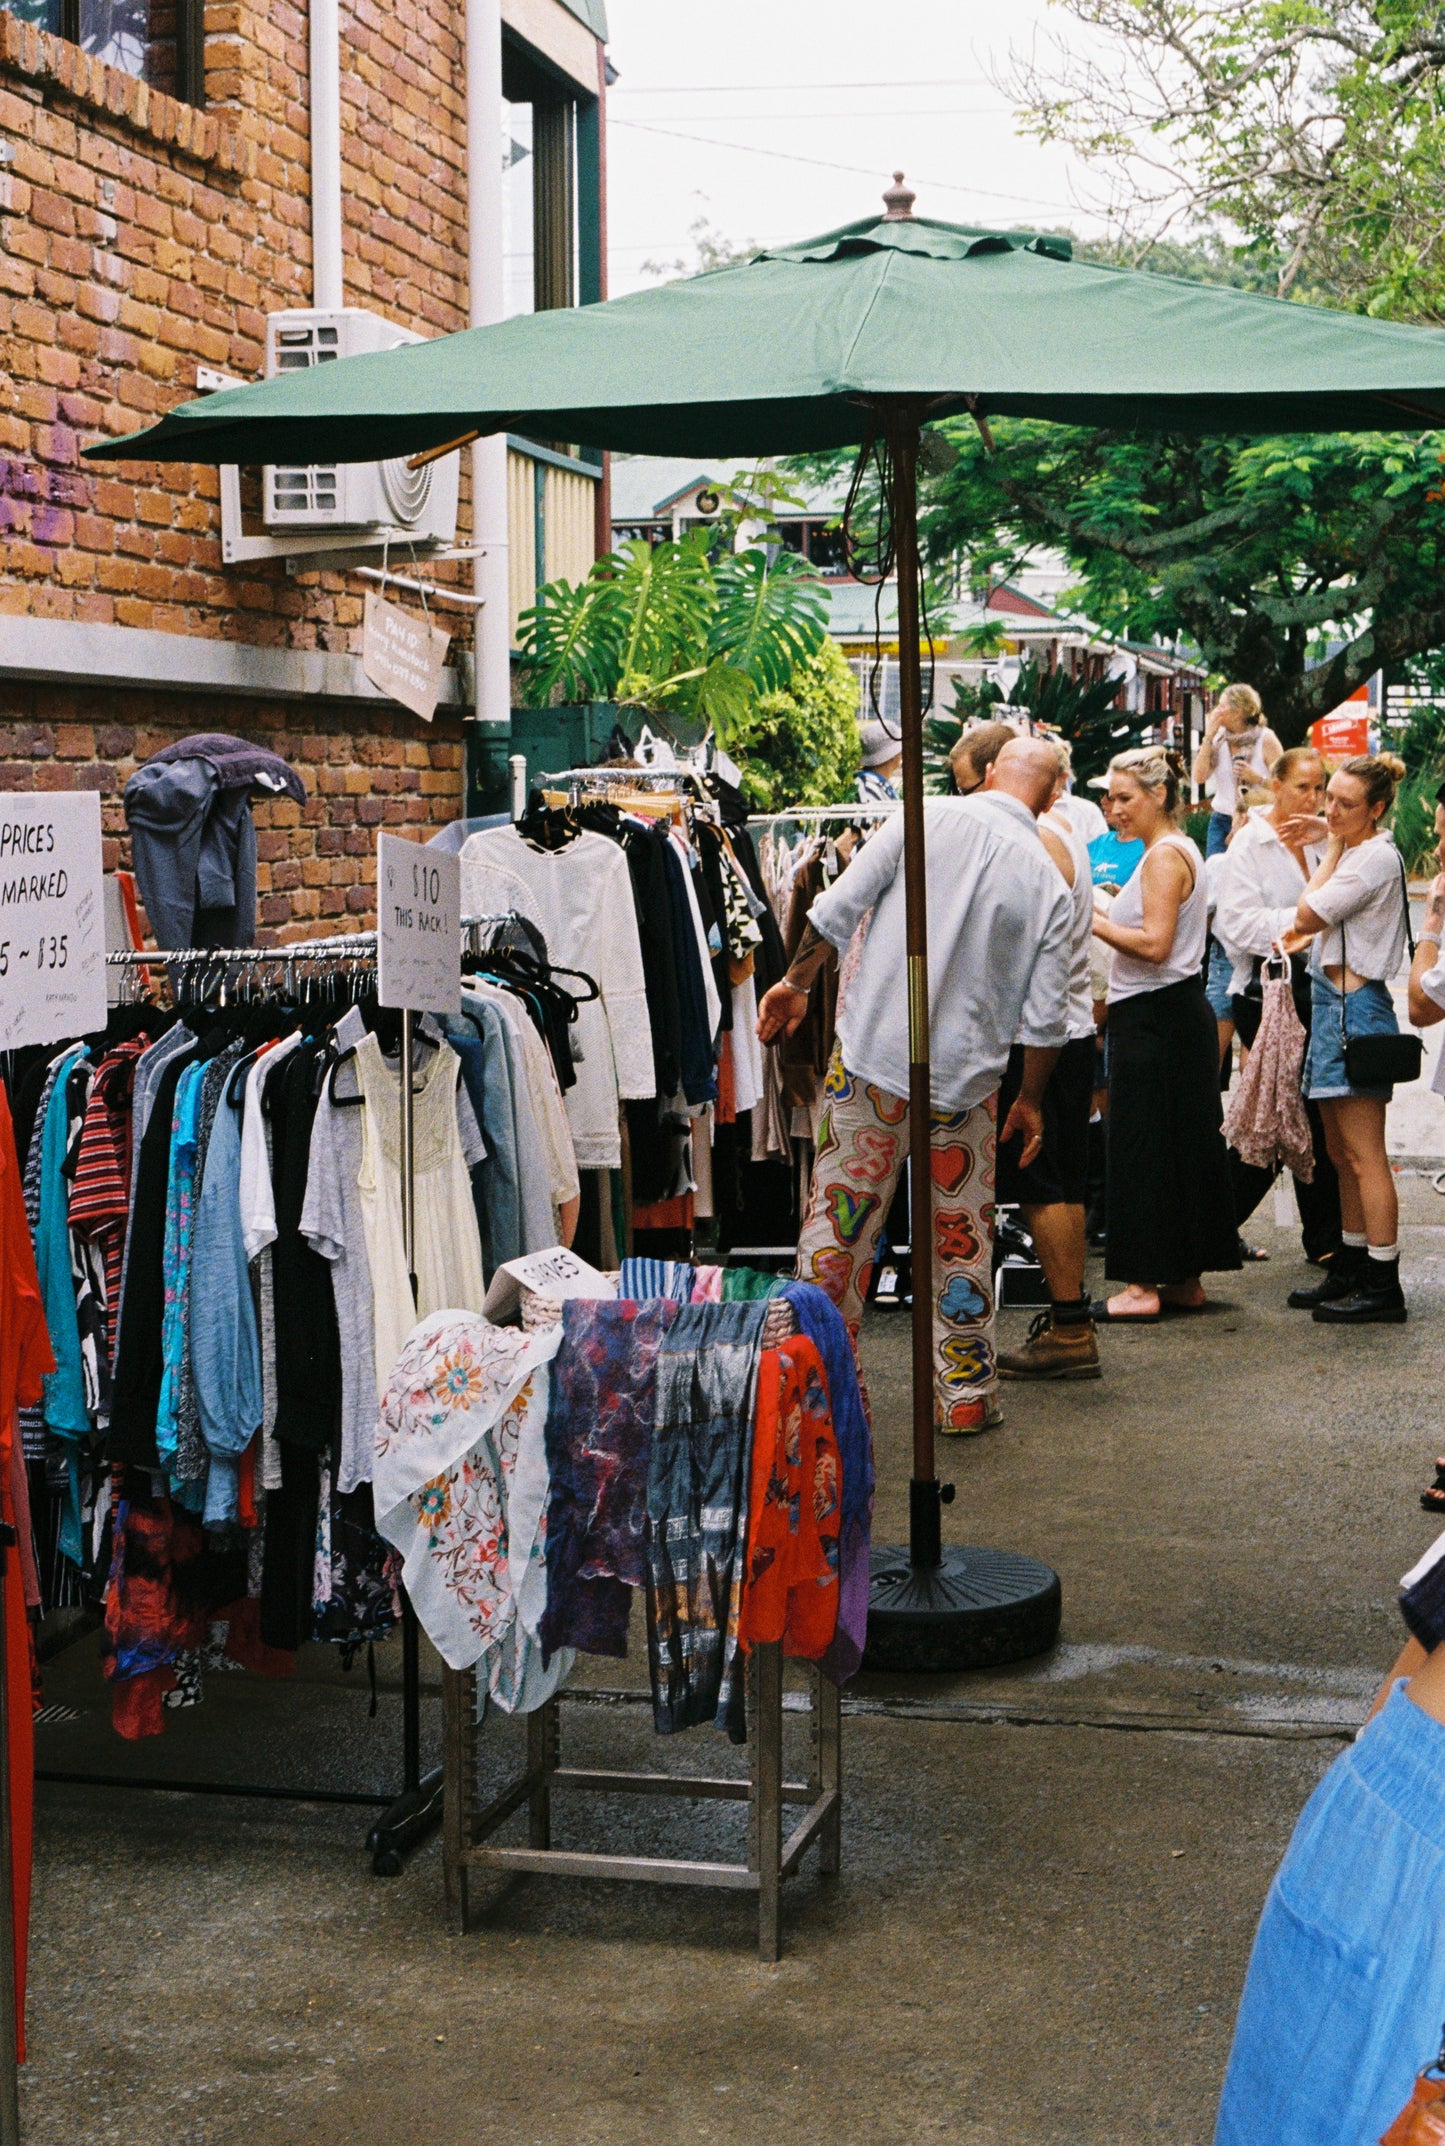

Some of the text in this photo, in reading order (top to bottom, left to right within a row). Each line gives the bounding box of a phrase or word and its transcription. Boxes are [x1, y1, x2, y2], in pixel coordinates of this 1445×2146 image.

[0, 823, 55, 857] PRICES
[2, 869, 68, 907] MARKED
[413, 863, 440, 905] $10
[394, 906, 412, 928] THIS
